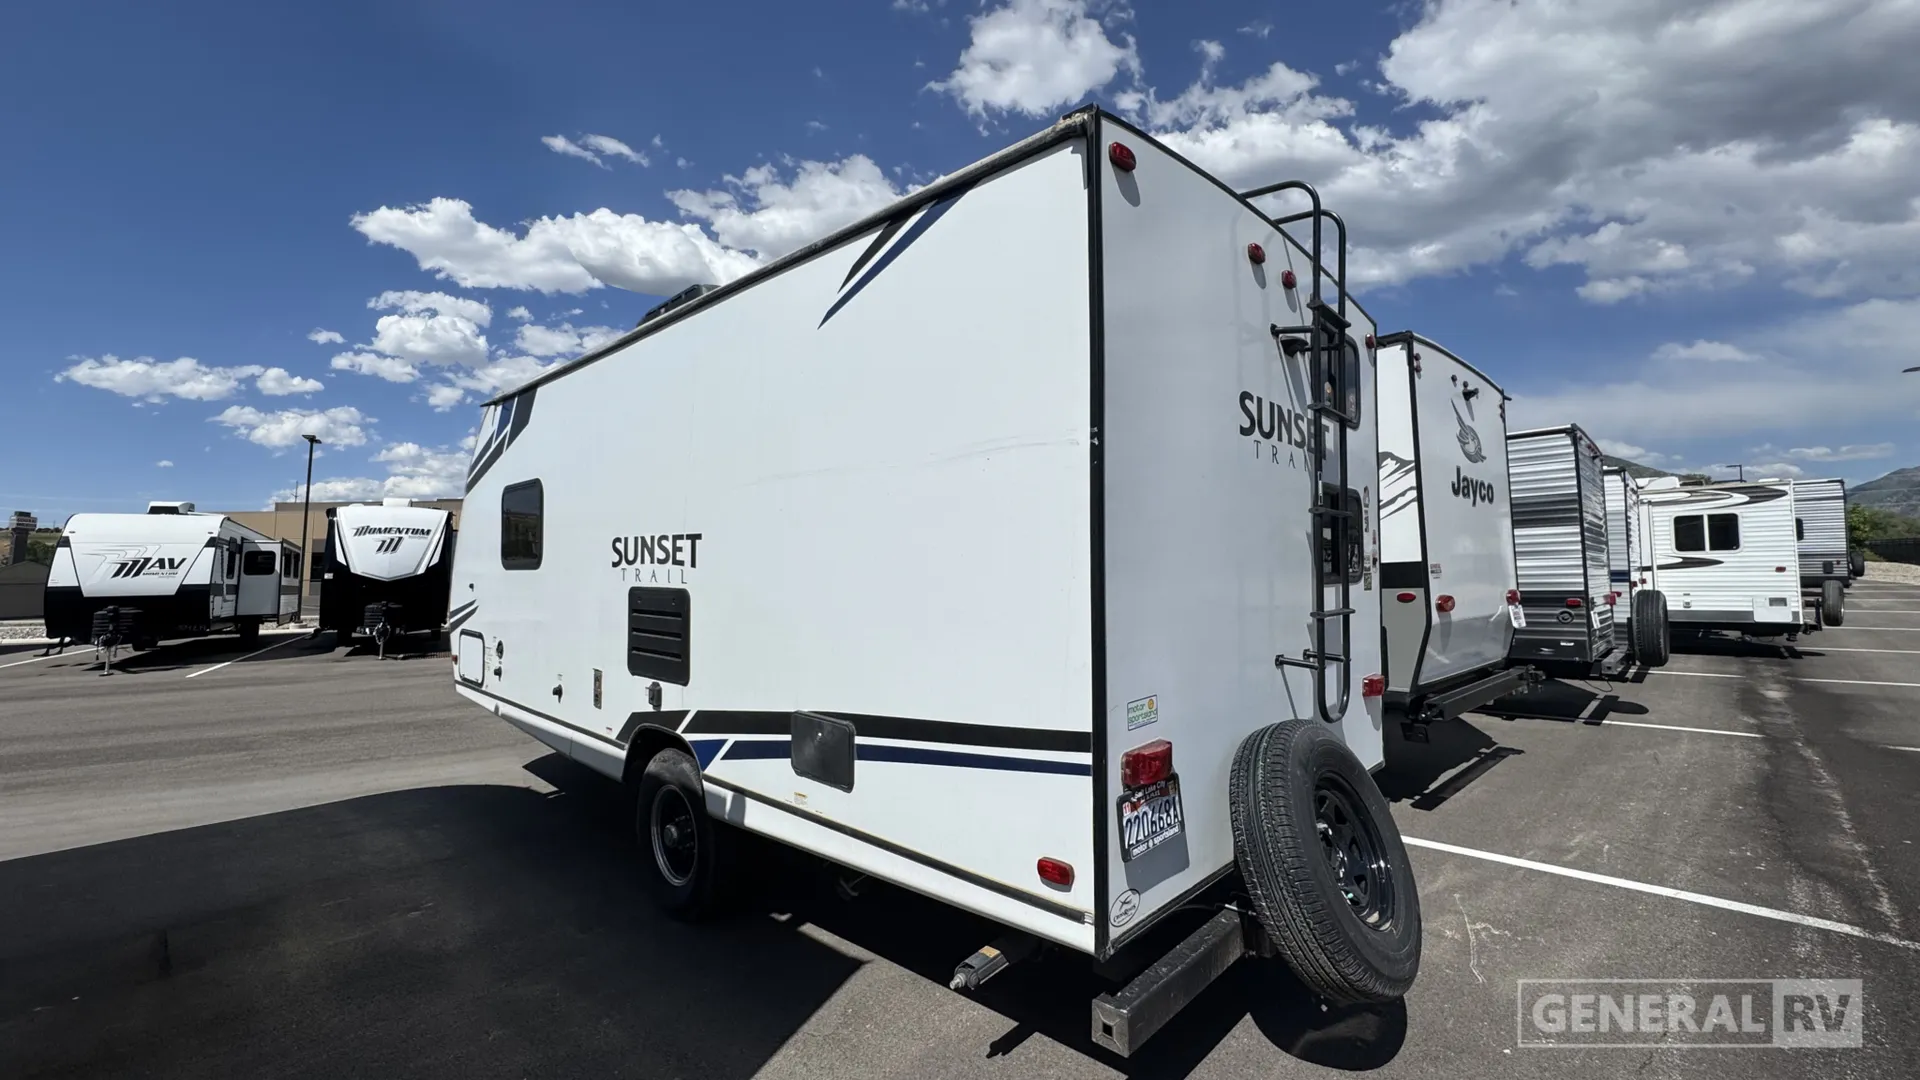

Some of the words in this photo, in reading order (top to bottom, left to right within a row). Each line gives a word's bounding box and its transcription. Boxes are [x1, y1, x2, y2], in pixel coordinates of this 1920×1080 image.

[1253, 440, 1308, 472] TRAI
[1451, 465, 1494, 507] Jayco
[353, 525, 432, 537] MOMENTUM
[611, 533, 702, 568] SUNSET
[621, 567, 688, 584] TRAIL
[1132, 842, 1148, 856] motor
[1153, 825, 1179, 845] sportsland
